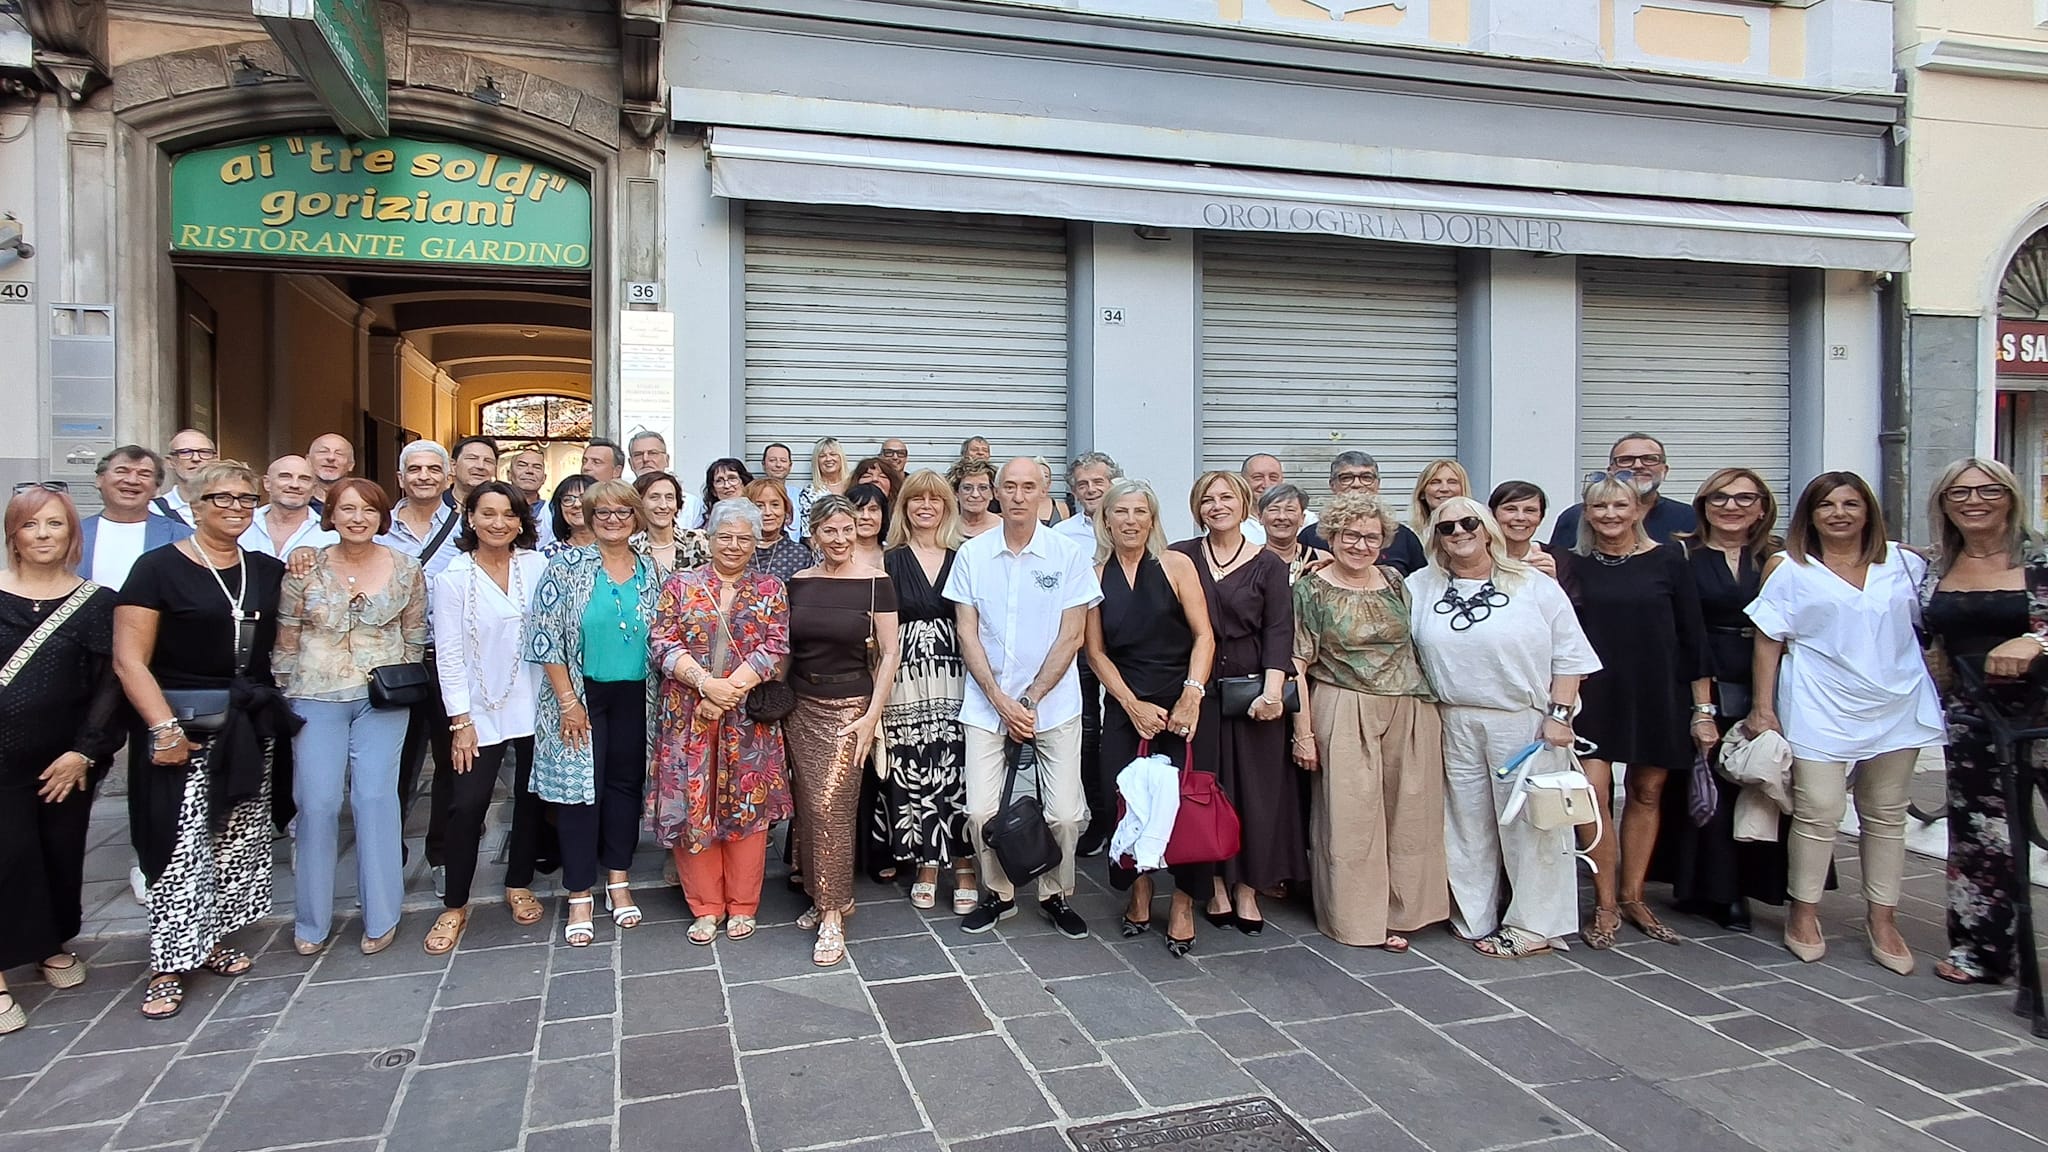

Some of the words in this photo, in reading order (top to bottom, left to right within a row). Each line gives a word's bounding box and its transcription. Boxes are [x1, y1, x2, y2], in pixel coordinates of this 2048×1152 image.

[220, 144, 274, 184] ai
[286, 136, 396, 173] "tre
[410, 153, 568, 202] soldi"
[260, 187, 516, 226] goriziani
[1203, 202, 1409, 240] OROLOGERIA
[1418, 212, 1568, 252] DOBNER
[178, 224, 405, 257] RISTORANTE
[420, 236, 587, 265] GIARDINO
[0, 284, 28, 298] 40
[633, 285, 654, 298] 36
[1104, 310, 1122, 321] 34
[1832, 346, 1846, 357] 32
